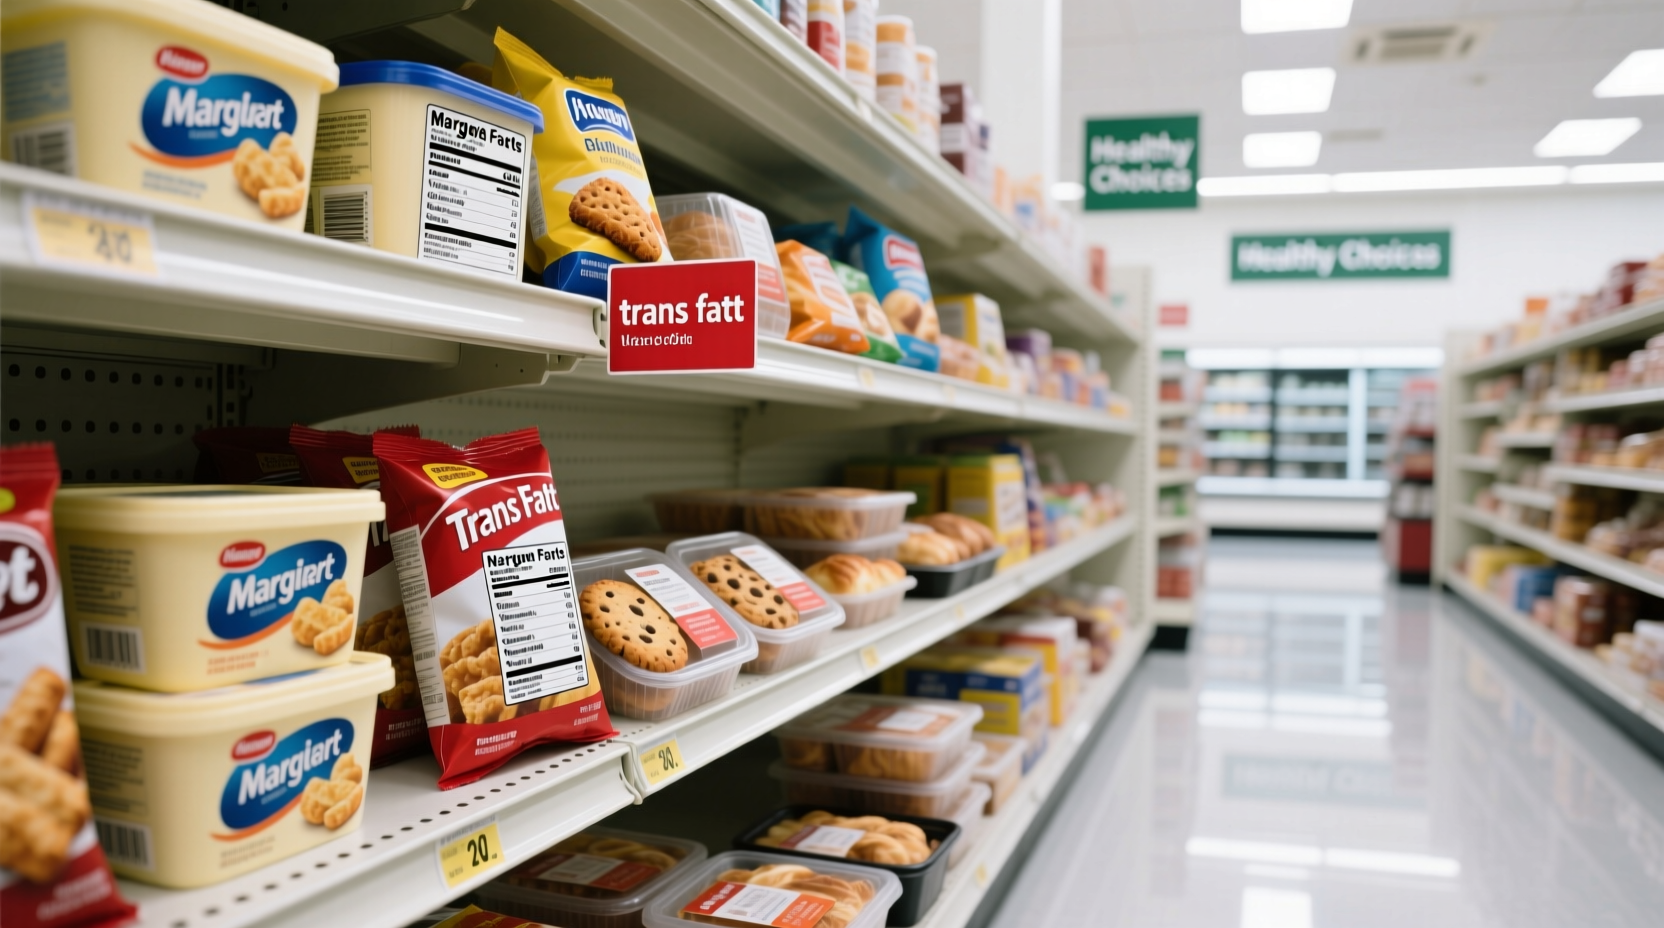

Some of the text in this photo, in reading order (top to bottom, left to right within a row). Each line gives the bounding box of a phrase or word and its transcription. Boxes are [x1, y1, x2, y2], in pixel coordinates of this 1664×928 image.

[1090, 131, 1195, 170] Healthy
[1089, 163, 1194, 195] Choices
[1238, 238, 1442, 278] Healthy Choices
[619, 292, 745, 326] trans fatt
[445, 483, 560, 552] Trans Fatt
[467, 833, 489, 868] 20
